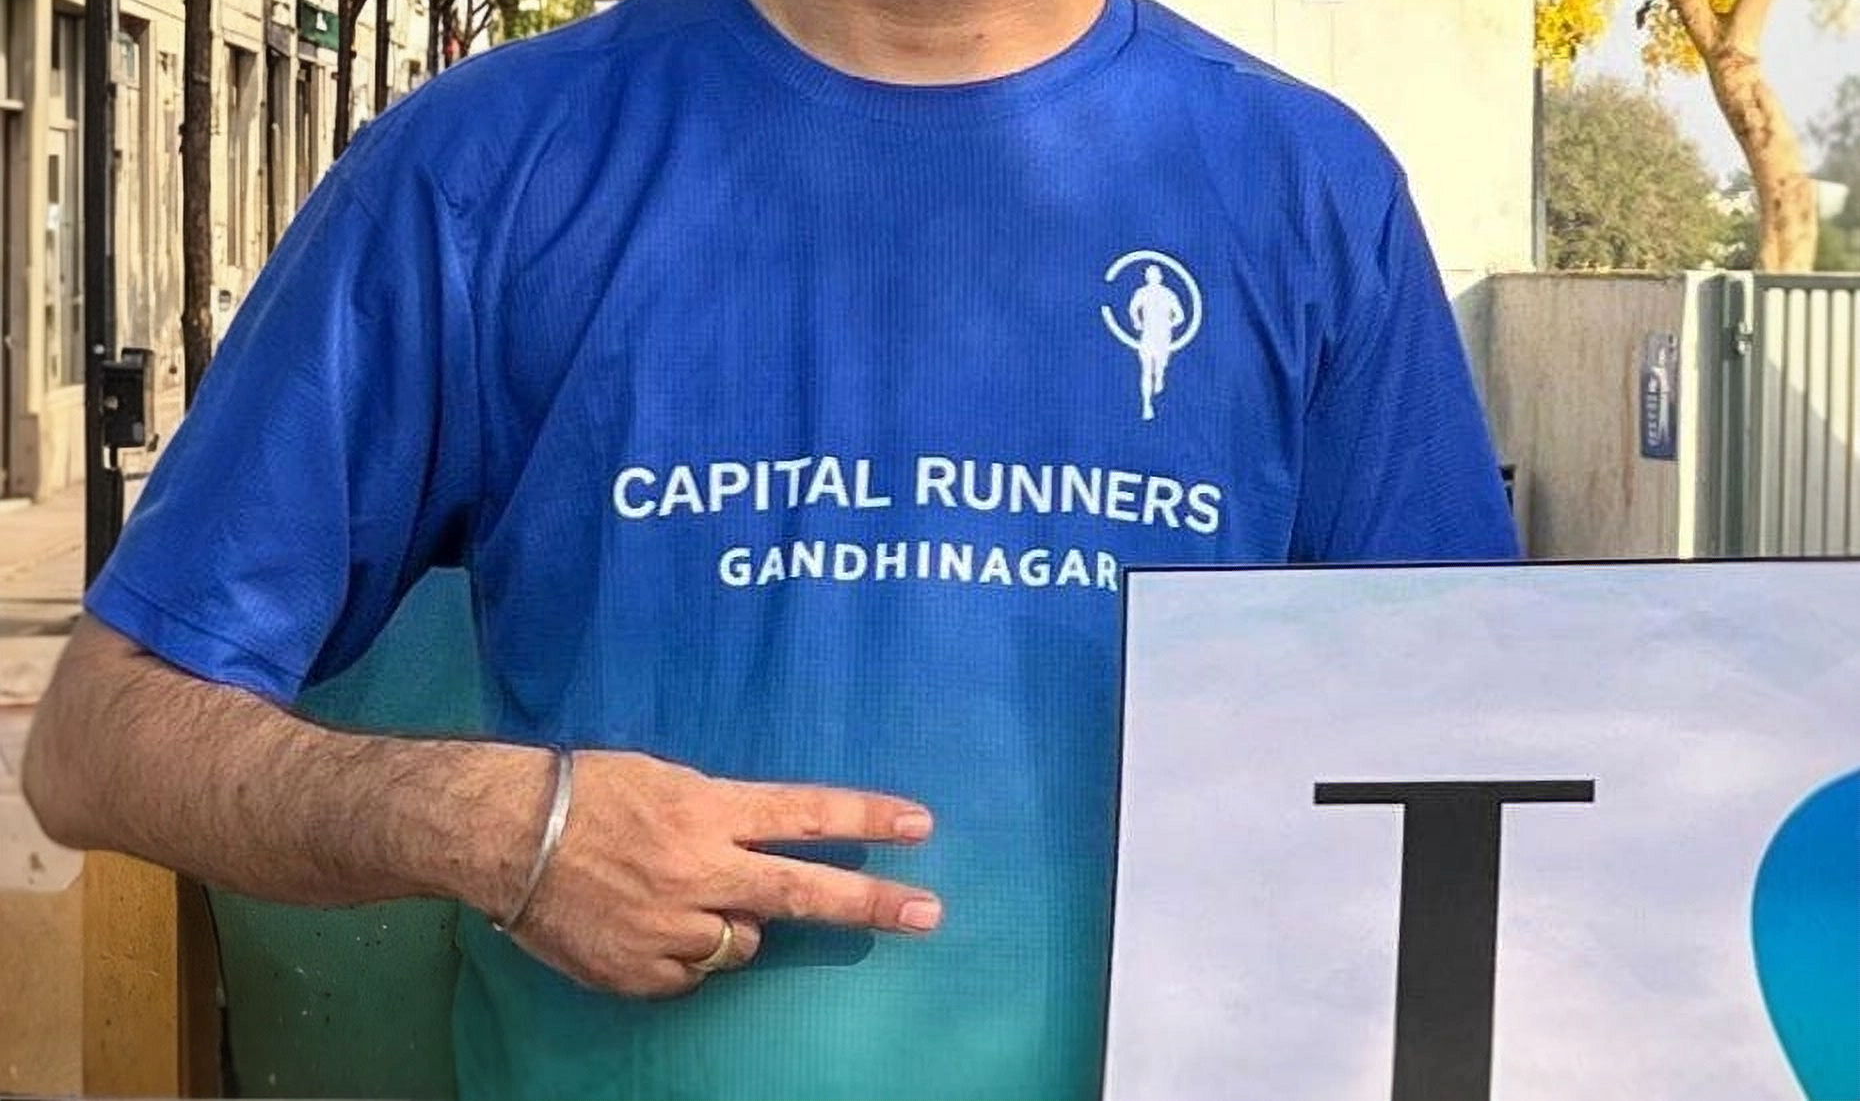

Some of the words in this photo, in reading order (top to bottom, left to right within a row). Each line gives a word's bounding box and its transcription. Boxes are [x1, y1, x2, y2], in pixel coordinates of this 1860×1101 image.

[613, 455, 892, 519] CAPITAL
[915, 456, 1223, 534] RUNNERS
[719, 539, 1118, 591] GANDHINAGAR
